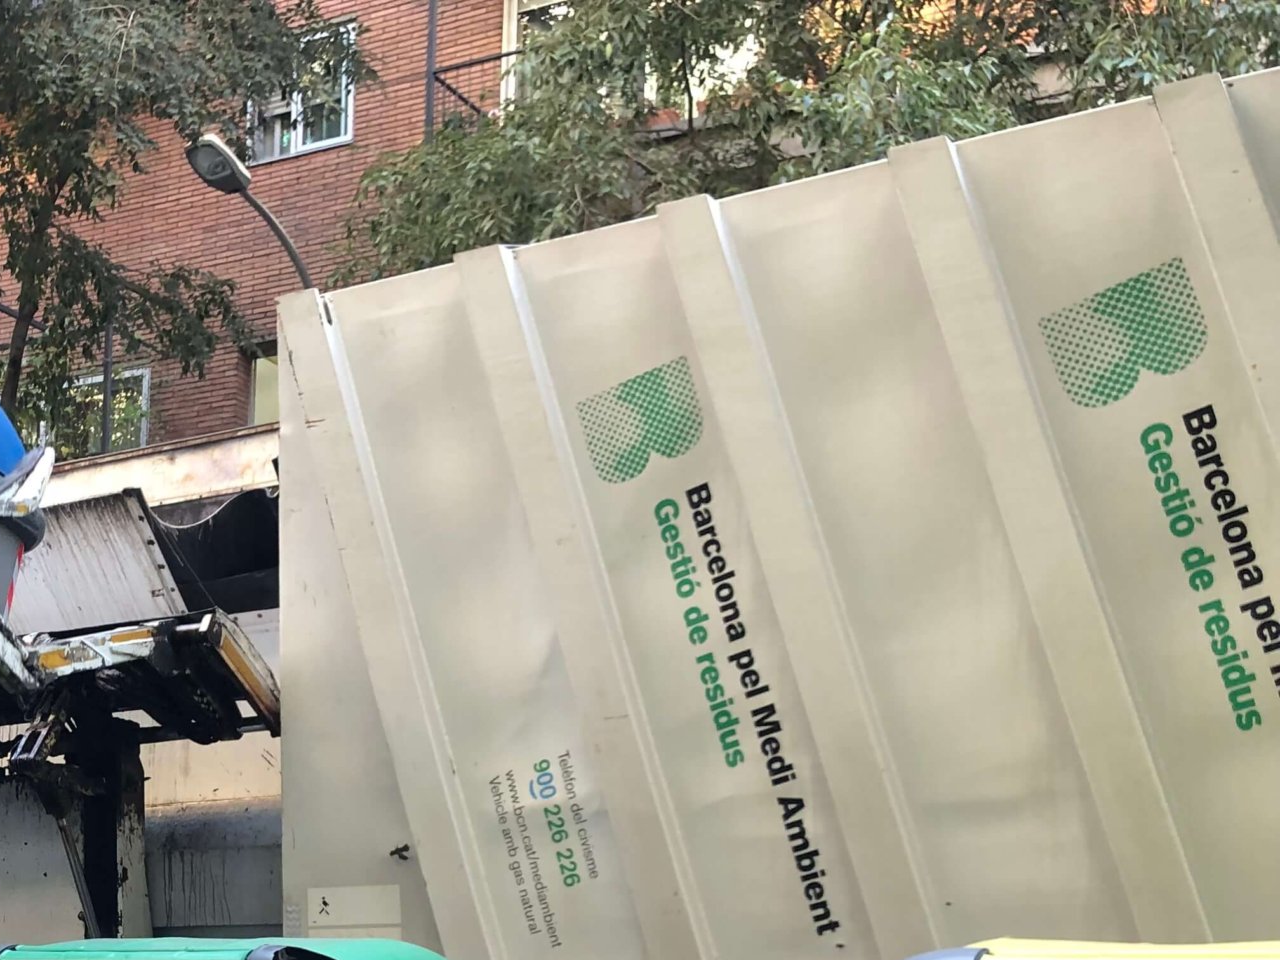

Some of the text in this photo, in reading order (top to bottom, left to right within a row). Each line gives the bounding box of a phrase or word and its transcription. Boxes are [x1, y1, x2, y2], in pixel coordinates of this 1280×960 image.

[1139, 421, 1263, 733] Gestió de residus
[1181, 403, 1265, 591] Barcelona
[653, 498, 746, 769] Gestió de residus
[684, 481, 841, 937] Barcelona pel Medi Ambient
[488, 775, 543, 936] Vehicle amb gas natural
[504, 768, 563, 949] www.bcn.cat/mediambient
[532, 758, 582, 888] 900 226 226
[569, 801, 588, 826] del
[577, 826, 600, 880] civisme
